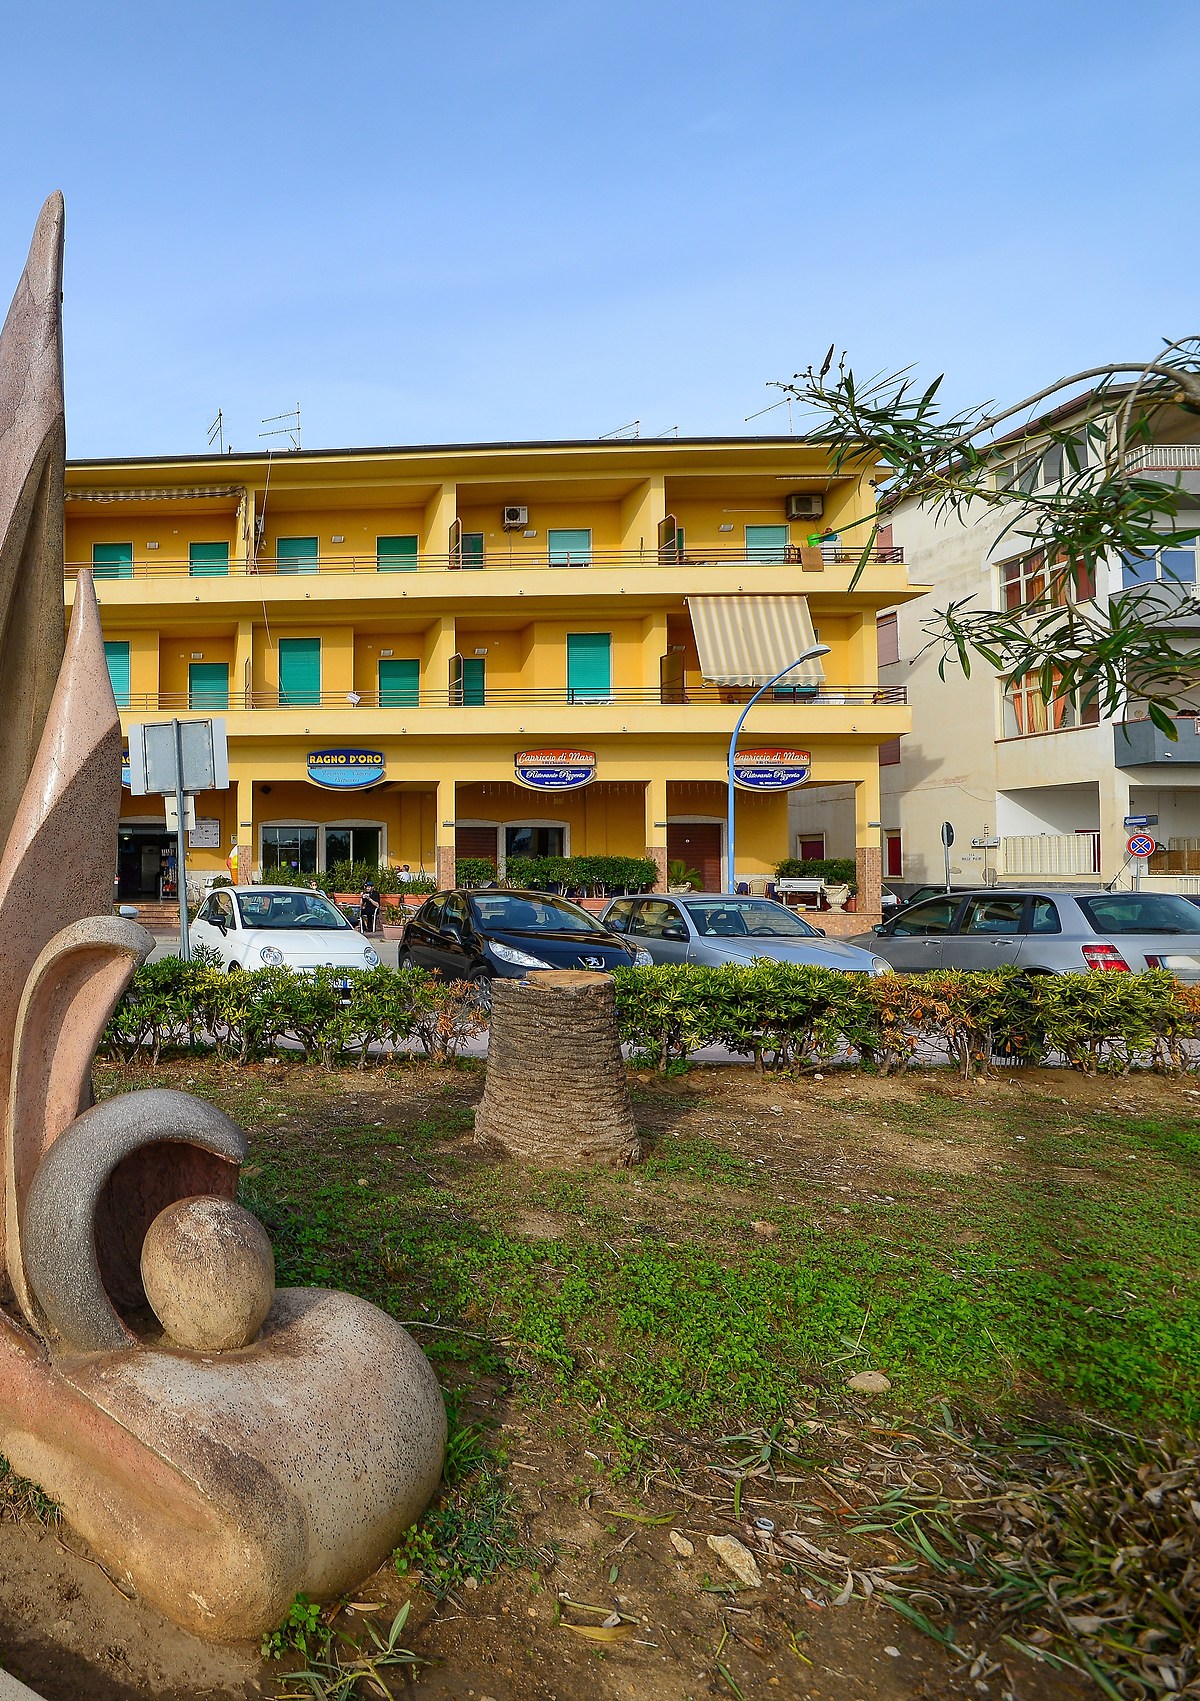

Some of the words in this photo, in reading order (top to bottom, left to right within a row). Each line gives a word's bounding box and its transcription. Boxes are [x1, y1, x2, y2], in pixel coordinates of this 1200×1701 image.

[310, 755, 346, 764] RAGNO
[349, 755, 382, 764] D'ORO
[519, 752, 556, 763] Capriccio
[569, 752, 593, 760] Mare
[734, 752, 771, 763] Capriccio
[772, 752, 781, 760] di
[783, 752, 808, 760] Mare
